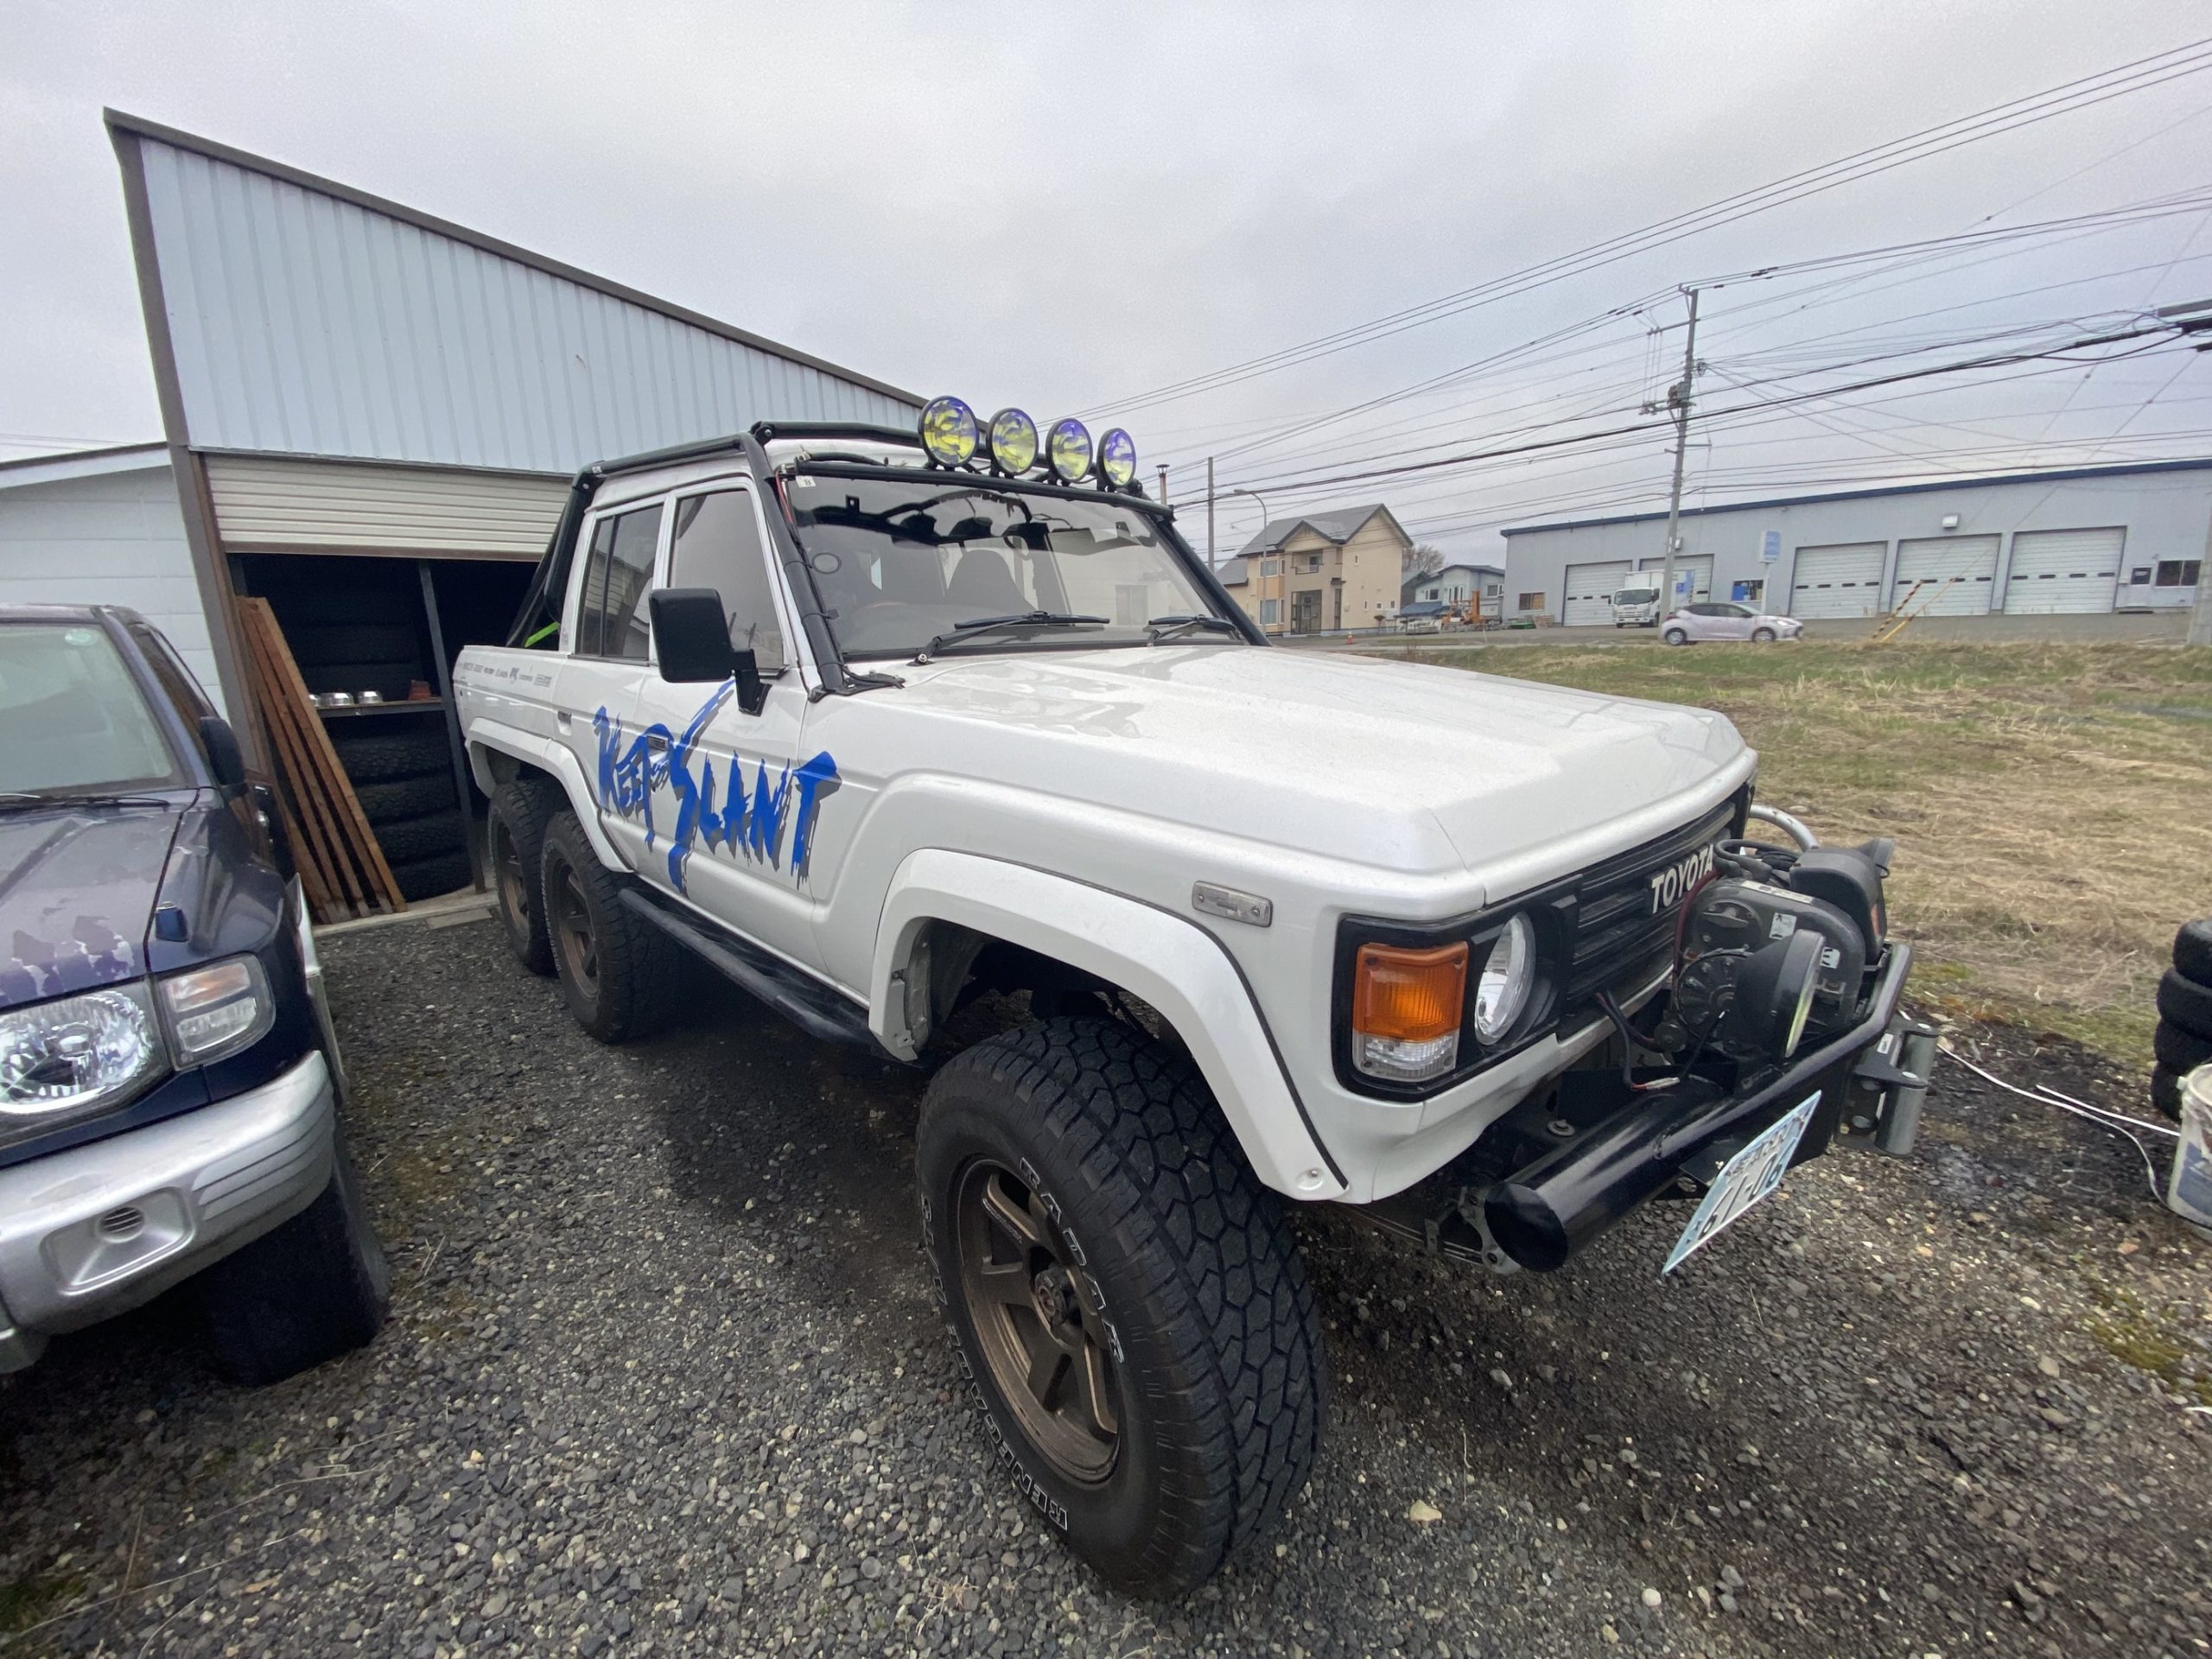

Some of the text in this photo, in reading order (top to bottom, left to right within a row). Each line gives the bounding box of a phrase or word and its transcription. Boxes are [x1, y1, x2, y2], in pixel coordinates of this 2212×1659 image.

[1651, 844, 1714, 914] TOYOTA
[1019, 1156, 1123, 1363] RADAR
[945, 1324, 1068, 1531] RENEGADE
